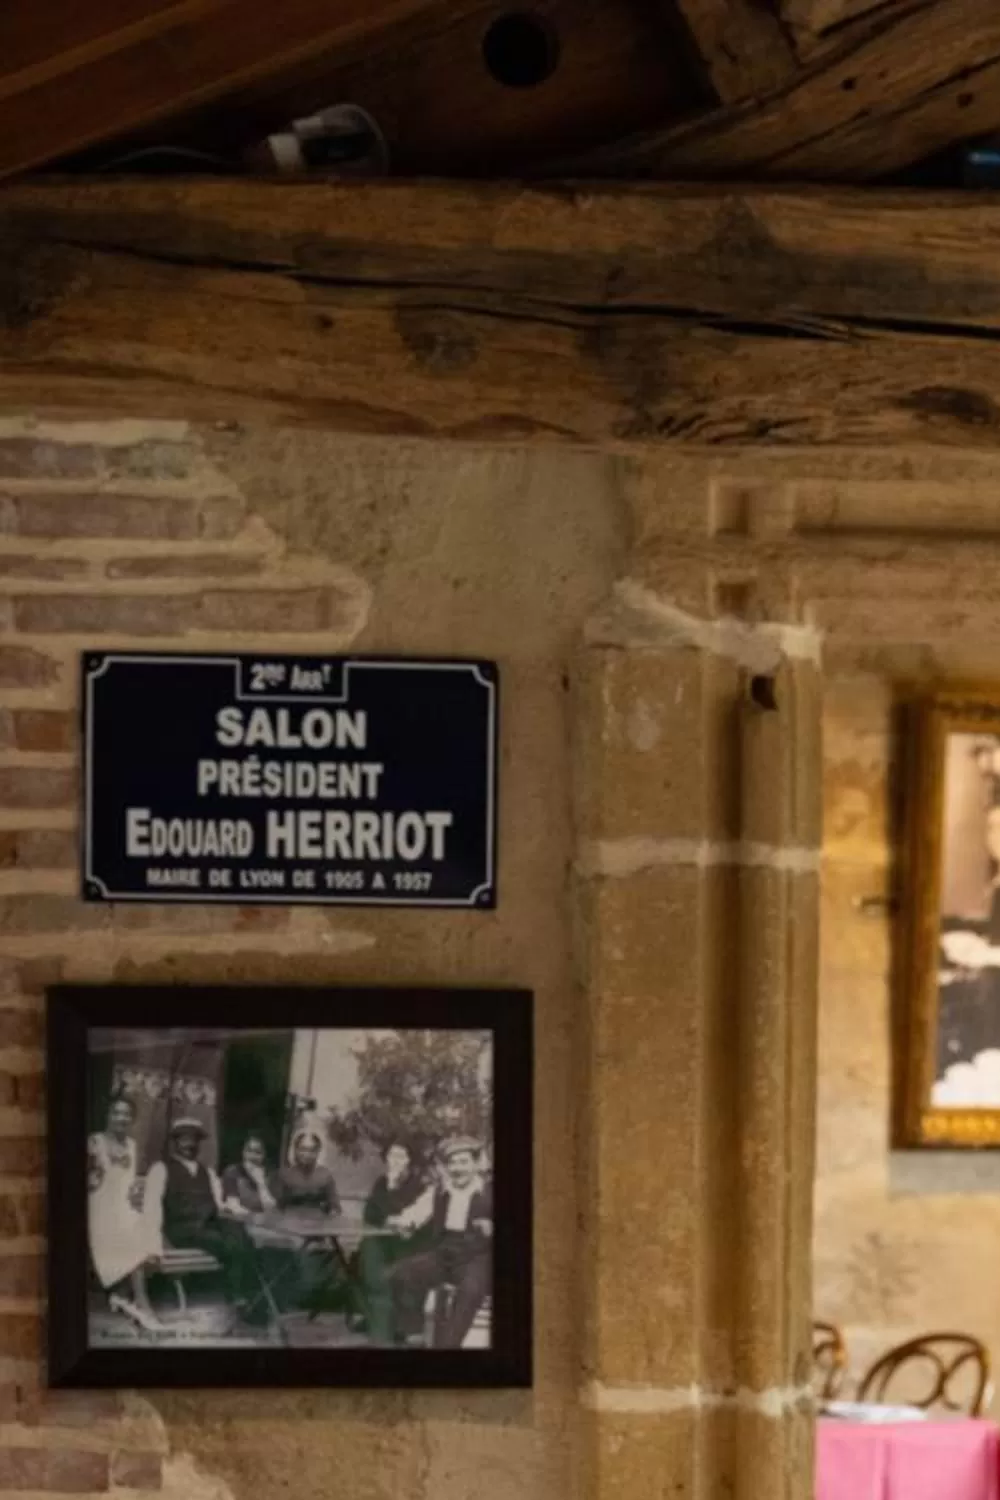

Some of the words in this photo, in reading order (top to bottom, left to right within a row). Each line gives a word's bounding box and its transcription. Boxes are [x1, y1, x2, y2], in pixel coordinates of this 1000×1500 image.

[216, 706, 367, 749] SALON
[197, 755, 384, 799] PRÉSIDENT
[266, 810, 453, 861] HERRIOT
[146, 868, 200, 887] MAIRE
[208, 868, 231, 887] DE
[239, 869, 285, 888] LYON
[292, 869, 316, 889] DE
[324, 870, 365, 889] 1905
[393, 871, 433, 891] 1957
